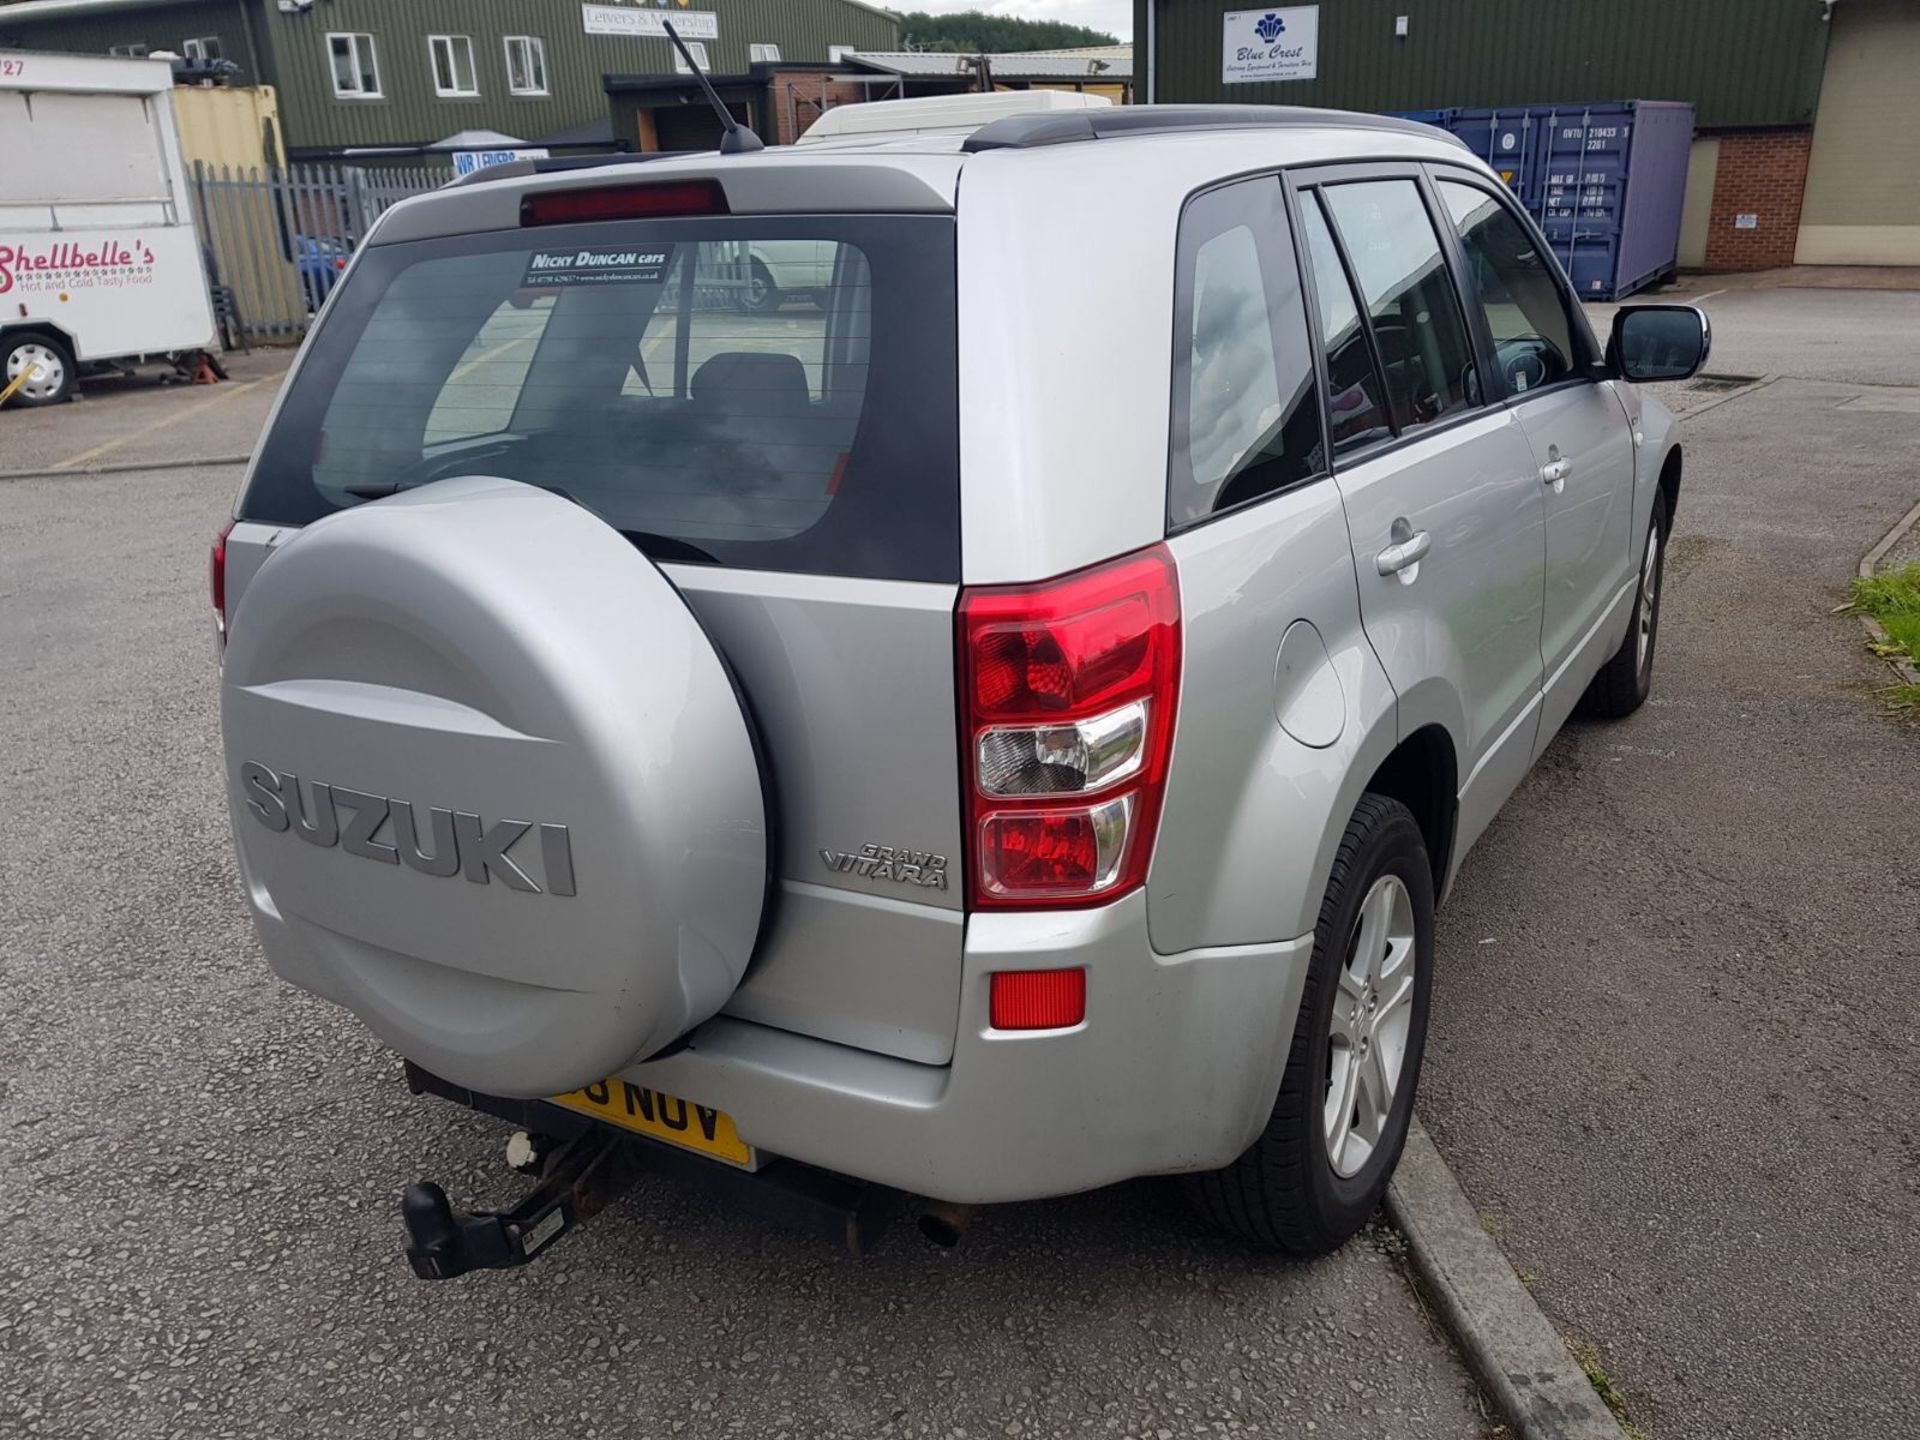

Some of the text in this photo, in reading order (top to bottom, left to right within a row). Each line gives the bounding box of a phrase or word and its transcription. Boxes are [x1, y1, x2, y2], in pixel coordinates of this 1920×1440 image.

[1236, 44, 1303, 61] Blue Crest
[1548, 197, 1560, 207] NET
[638, 253, 665, 264] cars
[21, 274, 152, 292] Hot and Cold Tasty Food
[241, 760, 577, 897] SUZUKI
[861, 842, 947, 869] GRAND
[819, 847, 948, 891] VITARA
